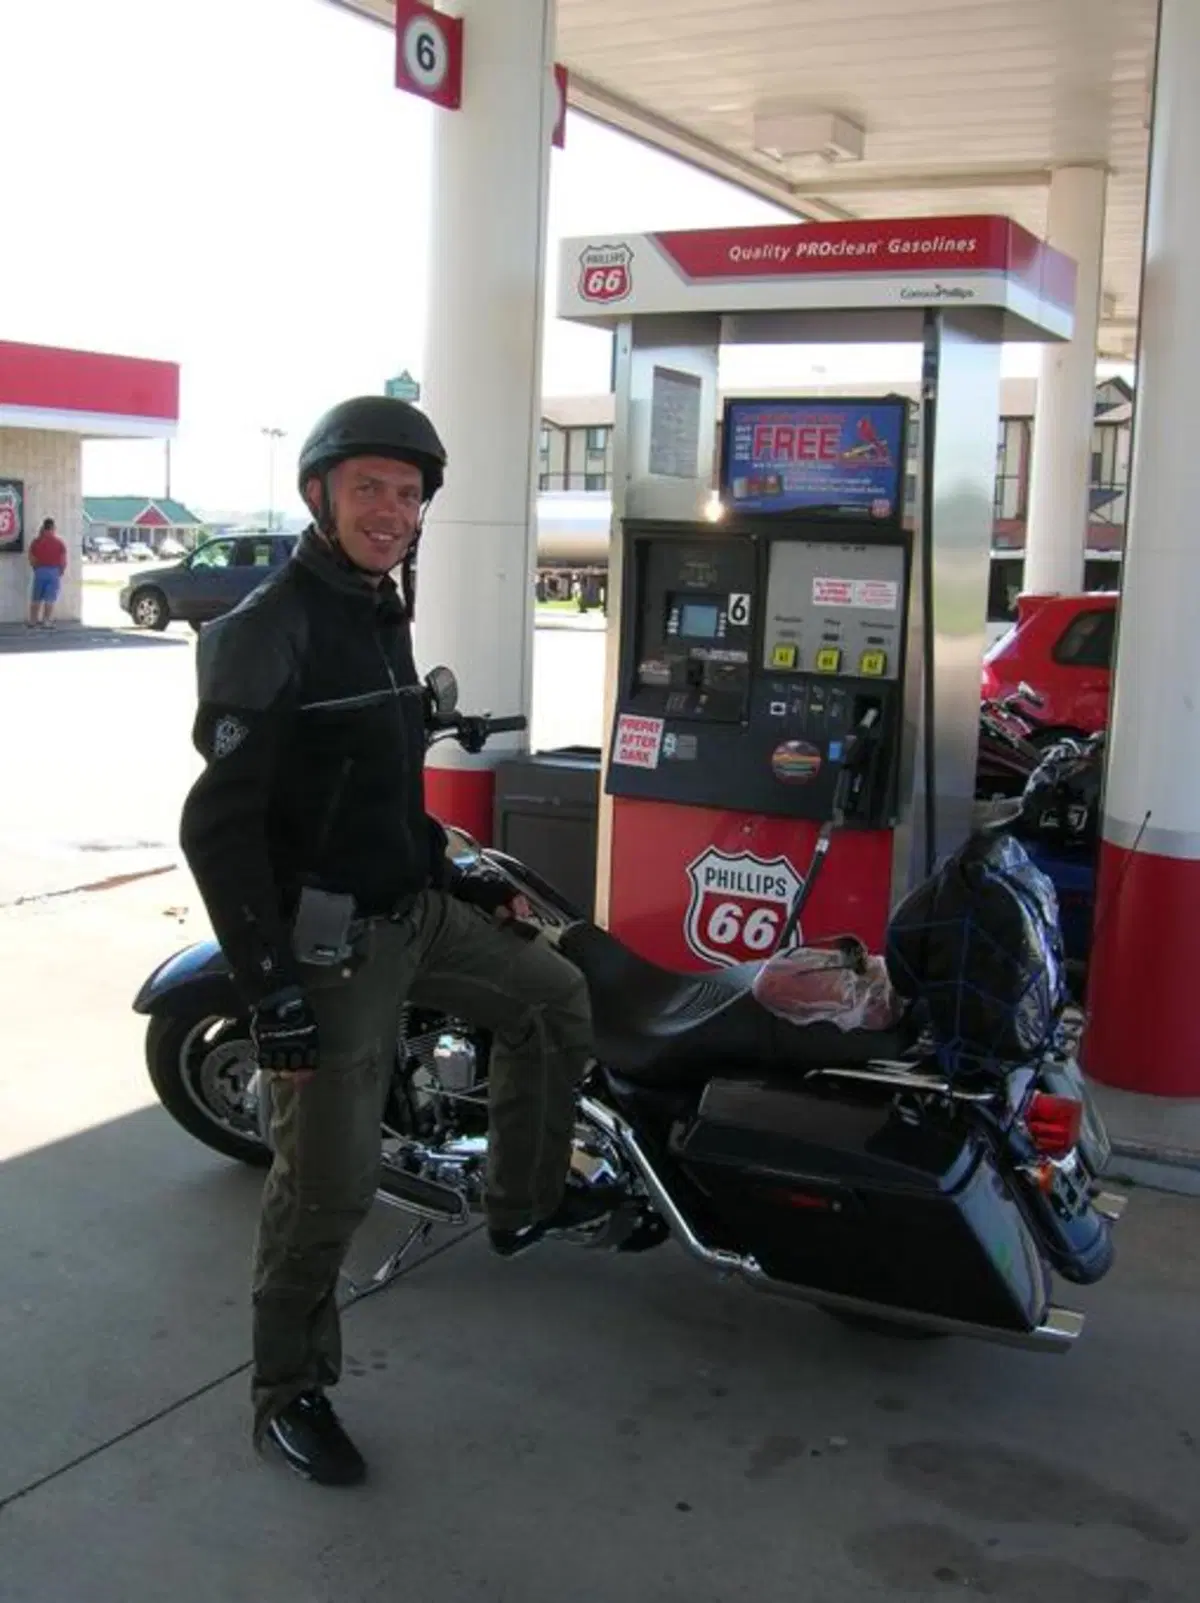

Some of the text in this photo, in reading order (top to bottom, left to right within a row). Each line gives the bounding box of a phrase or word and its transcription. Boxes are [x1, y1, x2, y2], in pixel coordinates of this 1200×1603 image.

[416, 32, 436, 71] 6
[586, 248, 627, 264] PHILLIPS
[729, 243, 791, 263] Quality
[887, 236, 977, 255] Gasolines
[588, 264, 624, 294] 66
[752, 423, 843, 462] FREE
[731, 595, 747, 622] 6
[619, 747, 651, 763] DARK
[704, 866, 788, 898] PHILLIPS
[707, 902, 780, 951] 66
